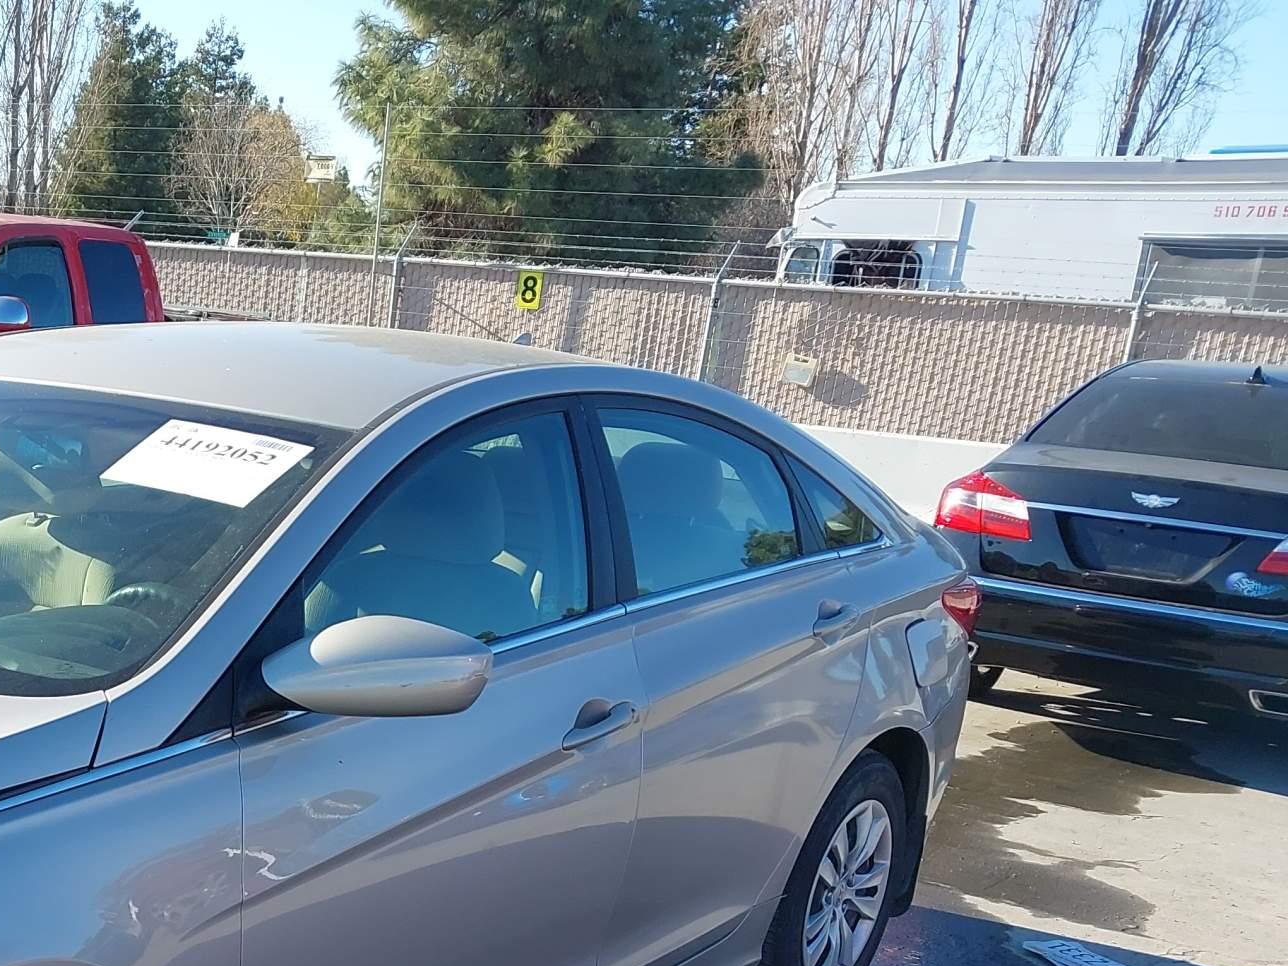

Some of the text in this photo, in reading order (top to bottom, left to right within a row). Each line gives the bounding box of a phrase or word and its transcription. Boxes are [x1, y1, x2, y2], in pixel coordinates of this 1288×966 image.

[1213, 205, 1241, 218] 510
[1245, 205, 1278, 218] 706
[520, 275, 538, 304] 8
[160, 435, 278, 465] 44192052
